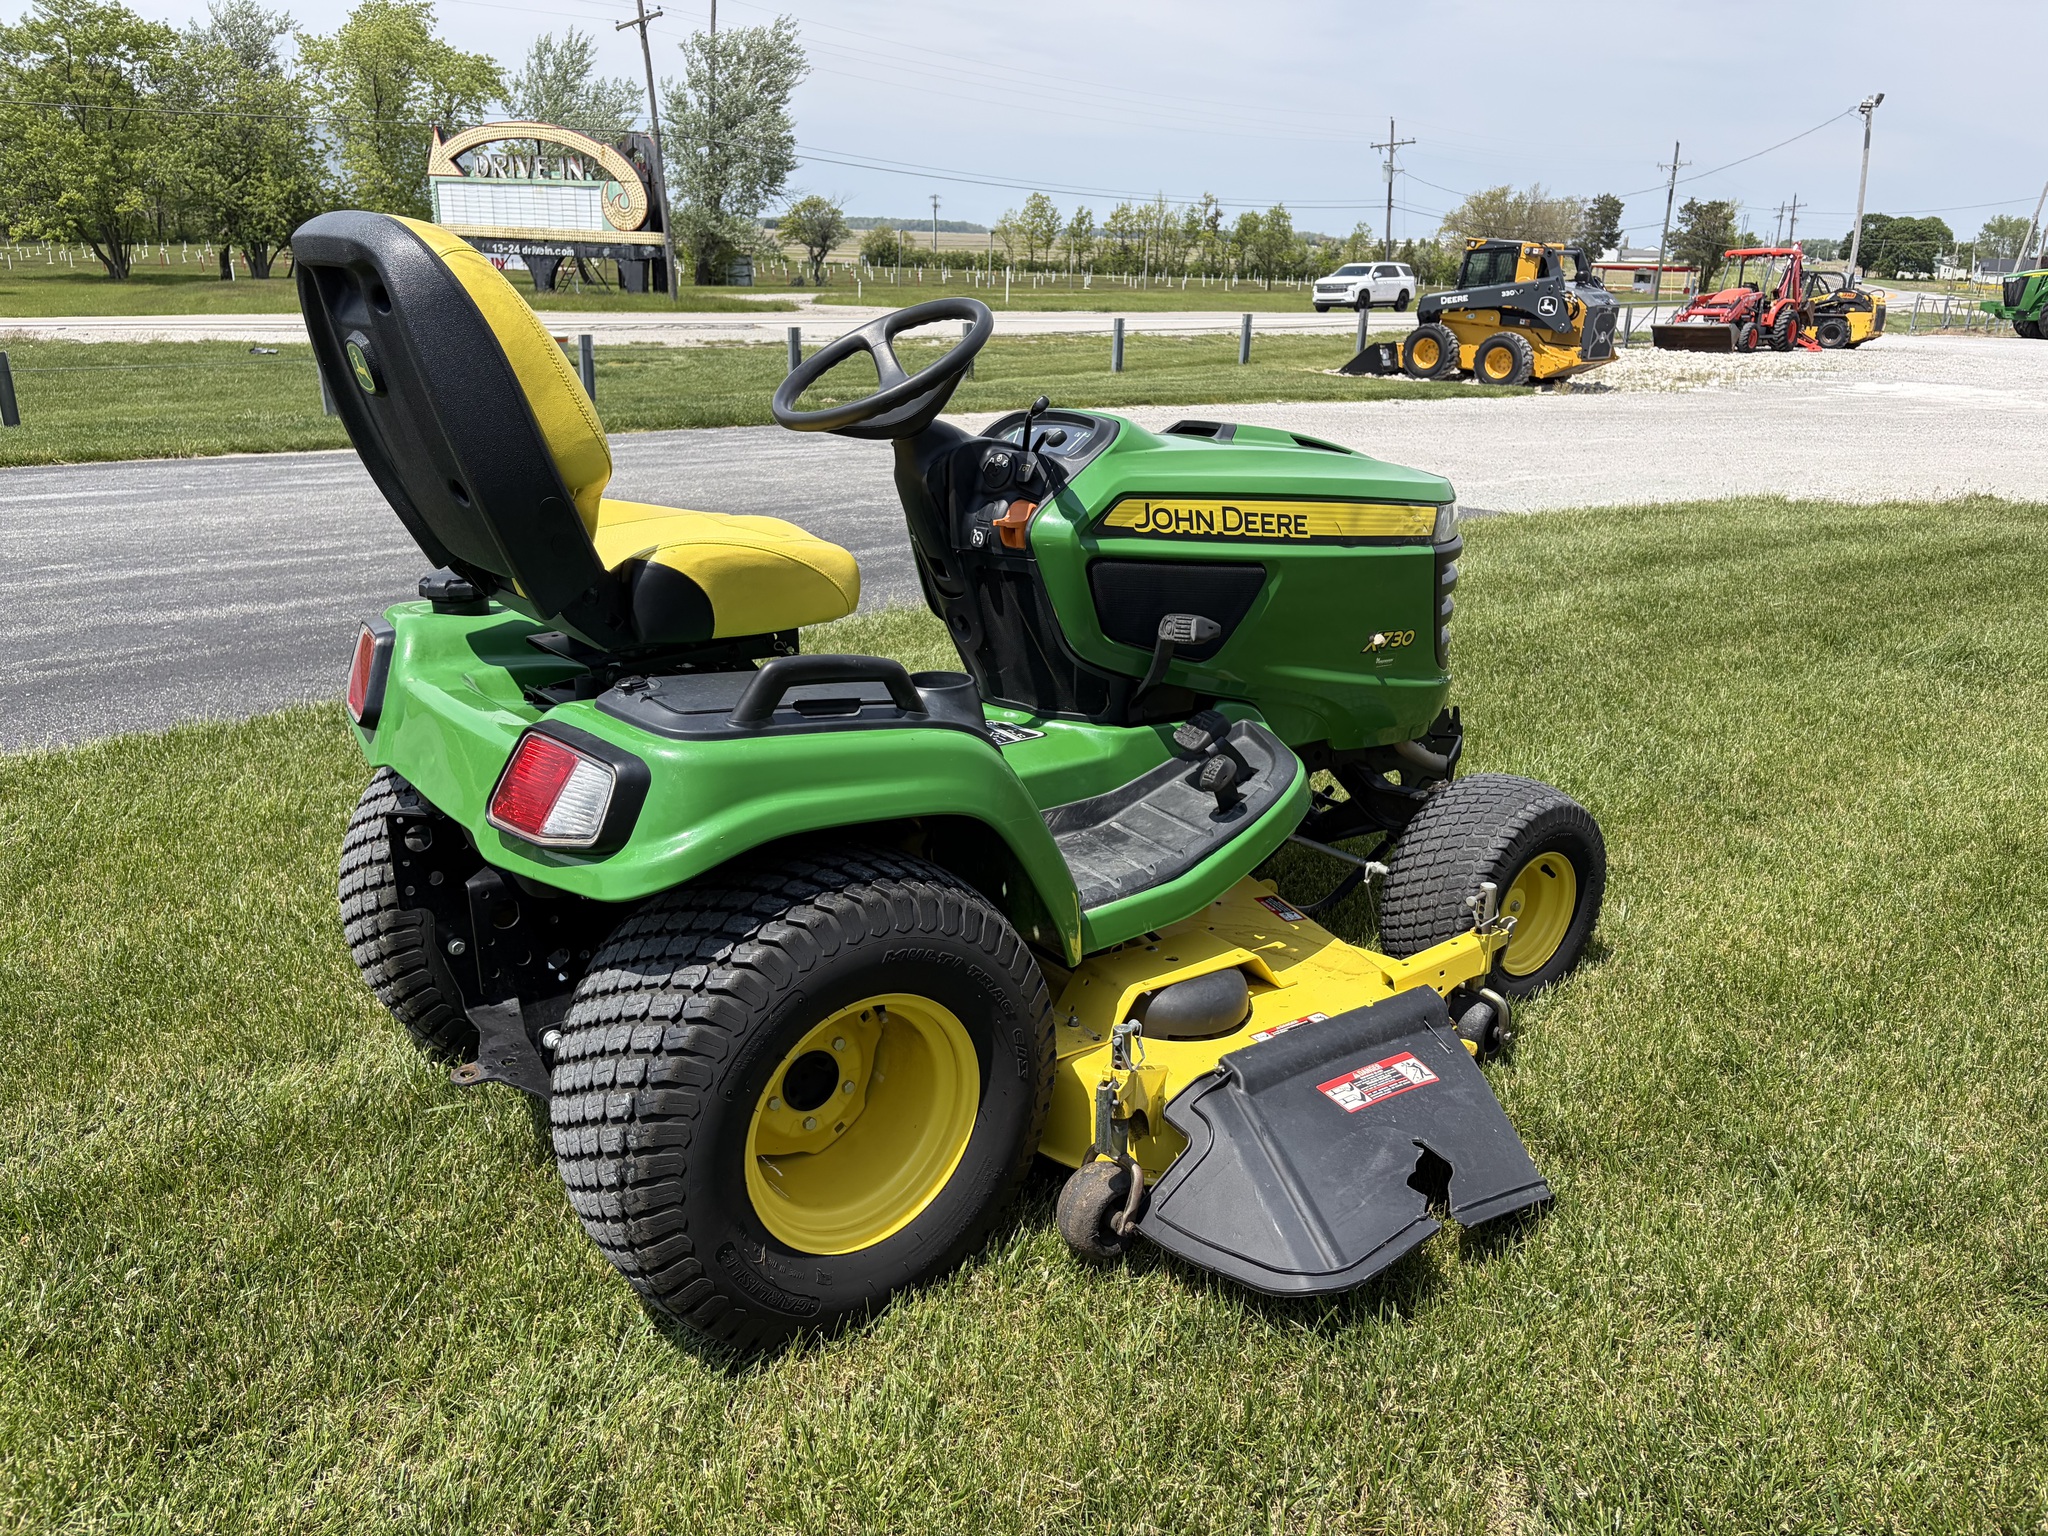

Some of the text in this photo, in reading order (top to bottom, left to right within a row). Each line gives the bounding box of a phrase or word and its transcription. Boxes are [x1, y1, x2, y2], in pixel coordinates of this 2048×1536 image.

[474, 153, 585, 180] DRIVE IN
[492, 243, 520, 254] 13-24
[1440, 294, 1469, 305] DEERE
[1134, 502, 1309, 536] JOHN DEERE
[882, 948, 964, 968] MULTI
[967, 963, 1016, 1017] TRAC
[721, 1249, 813, 1311] CARLISLE
